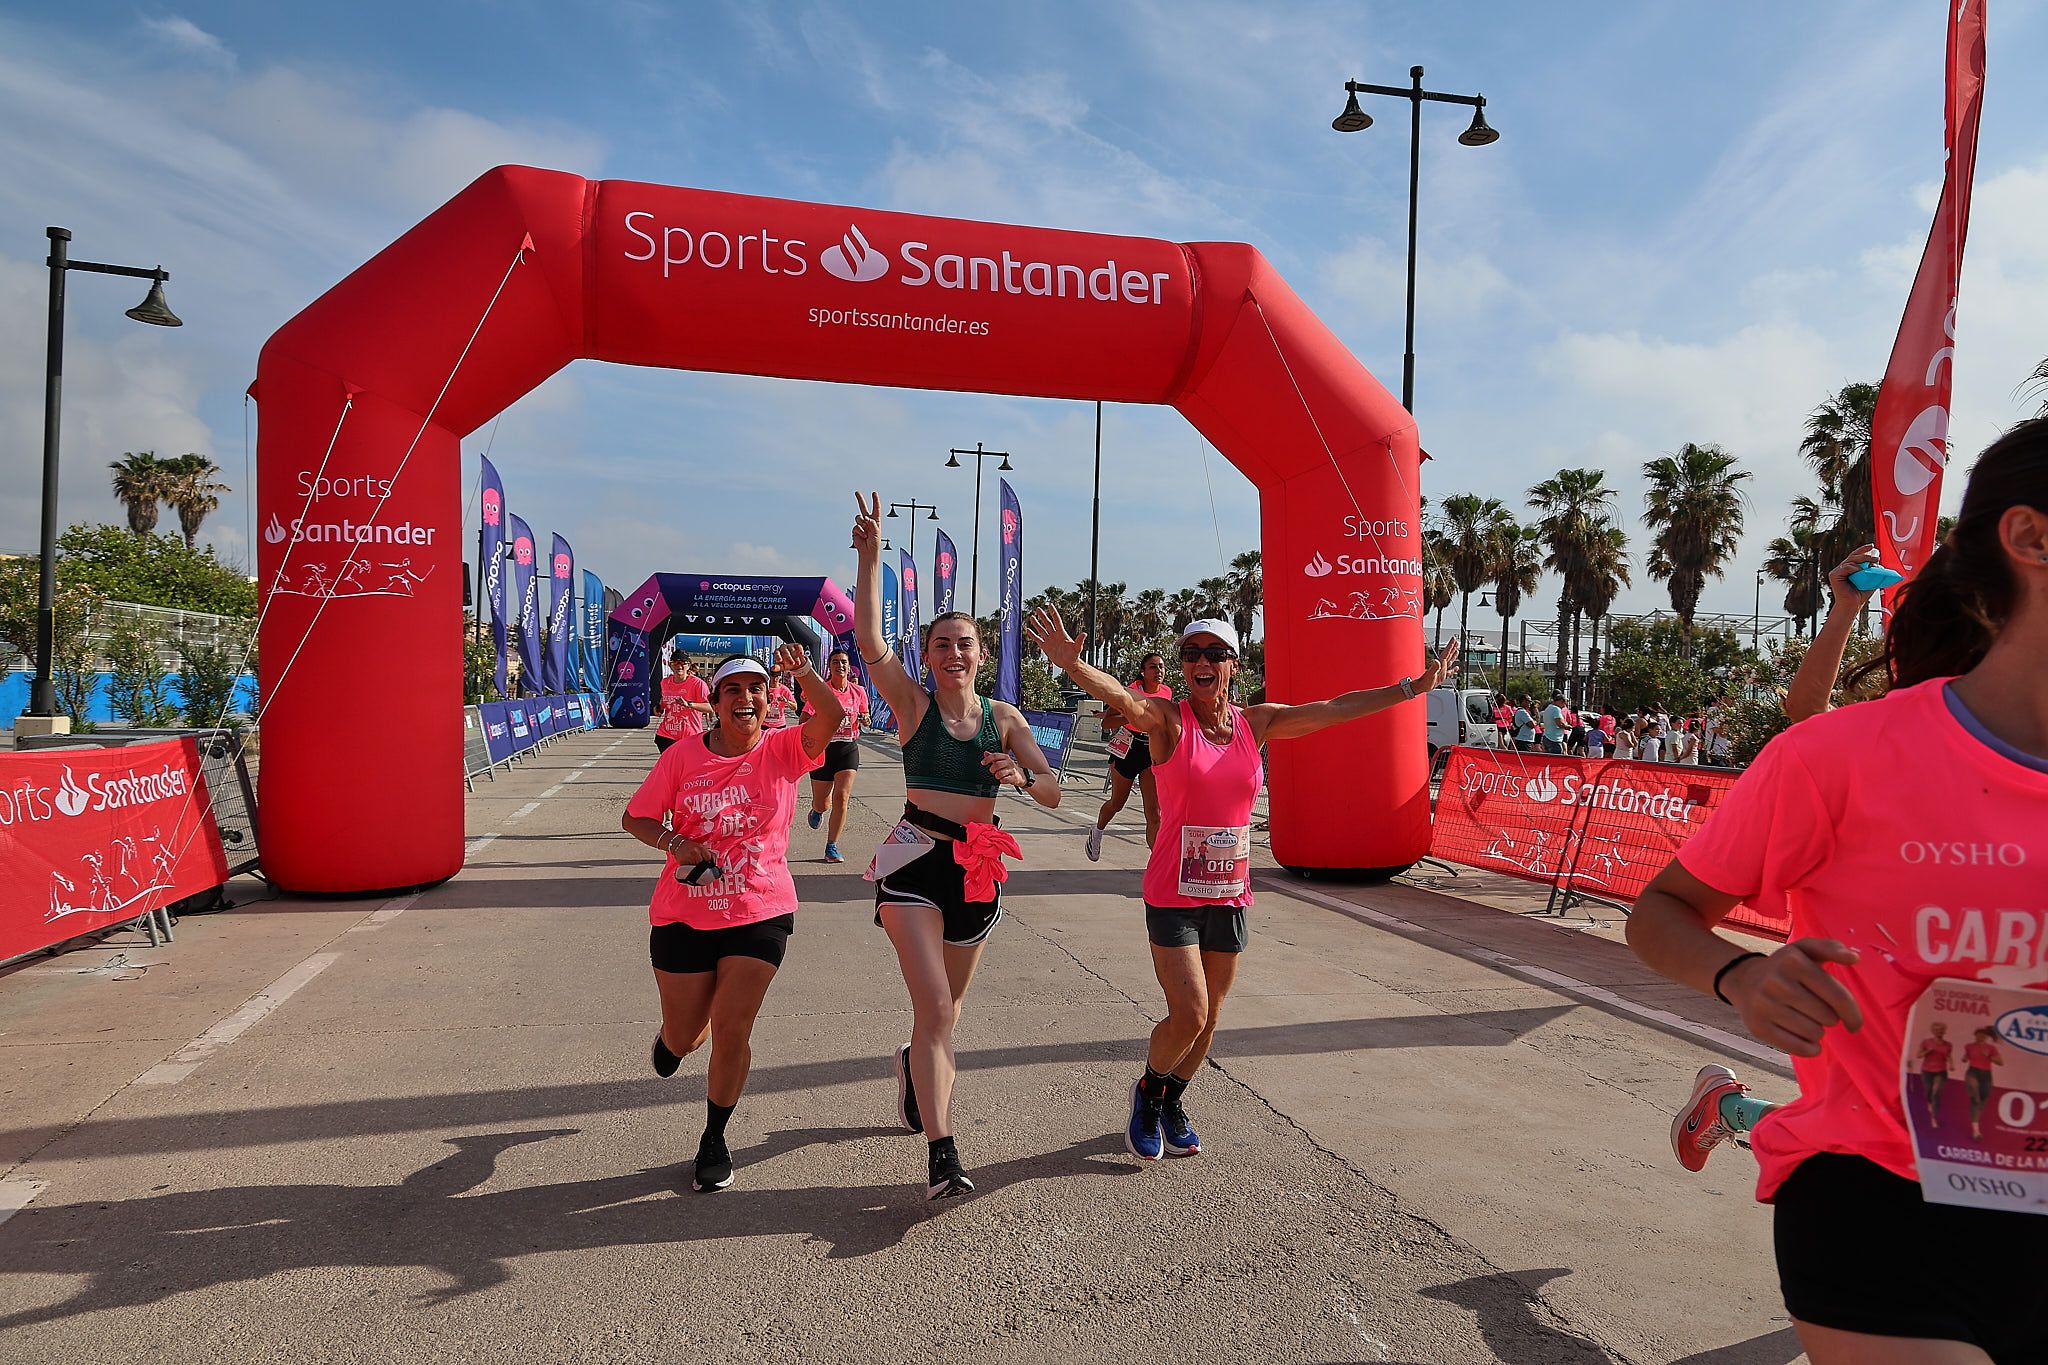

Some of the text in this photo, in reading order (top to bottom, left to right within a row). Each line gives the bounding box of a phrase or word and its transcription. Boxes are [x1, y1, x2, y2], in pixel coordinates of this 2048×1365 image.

[623, 210, 1170, 305] Sports Santander
[808, 306, 989, 337] sportssantander.es
[297, 471, 393, 503] Sports
[290, 518, 436, 547] Santander
[1343, 515, 1408, 541] Sports
[1337, 554, 1423, 577] Santande
[712, 582, 784, 594] octopus energy
[685, 614, 771, 625] VOLVO
[88, 764, 188, 812] Santander
[684, 779, 714, 791] OYSHO
[1459, 763, 1698, 824] Sports Santander
[1207, 860, 1234, 872] 016
[1900, 840, 2026, 867] OYSHO
[1187, 886, 1213, 894] OYSHO
[708, 898, 729, 910] 2026
[1933, 997, 1991, 1017] SUMA
[1937, 1144, 1992, 1165] CARRERA
[1995, 1153, 2015, 1168] DE
[2016, 1156, 2034, 1169] LA
[1948, 1172, 2027, 1199] OYSHO
